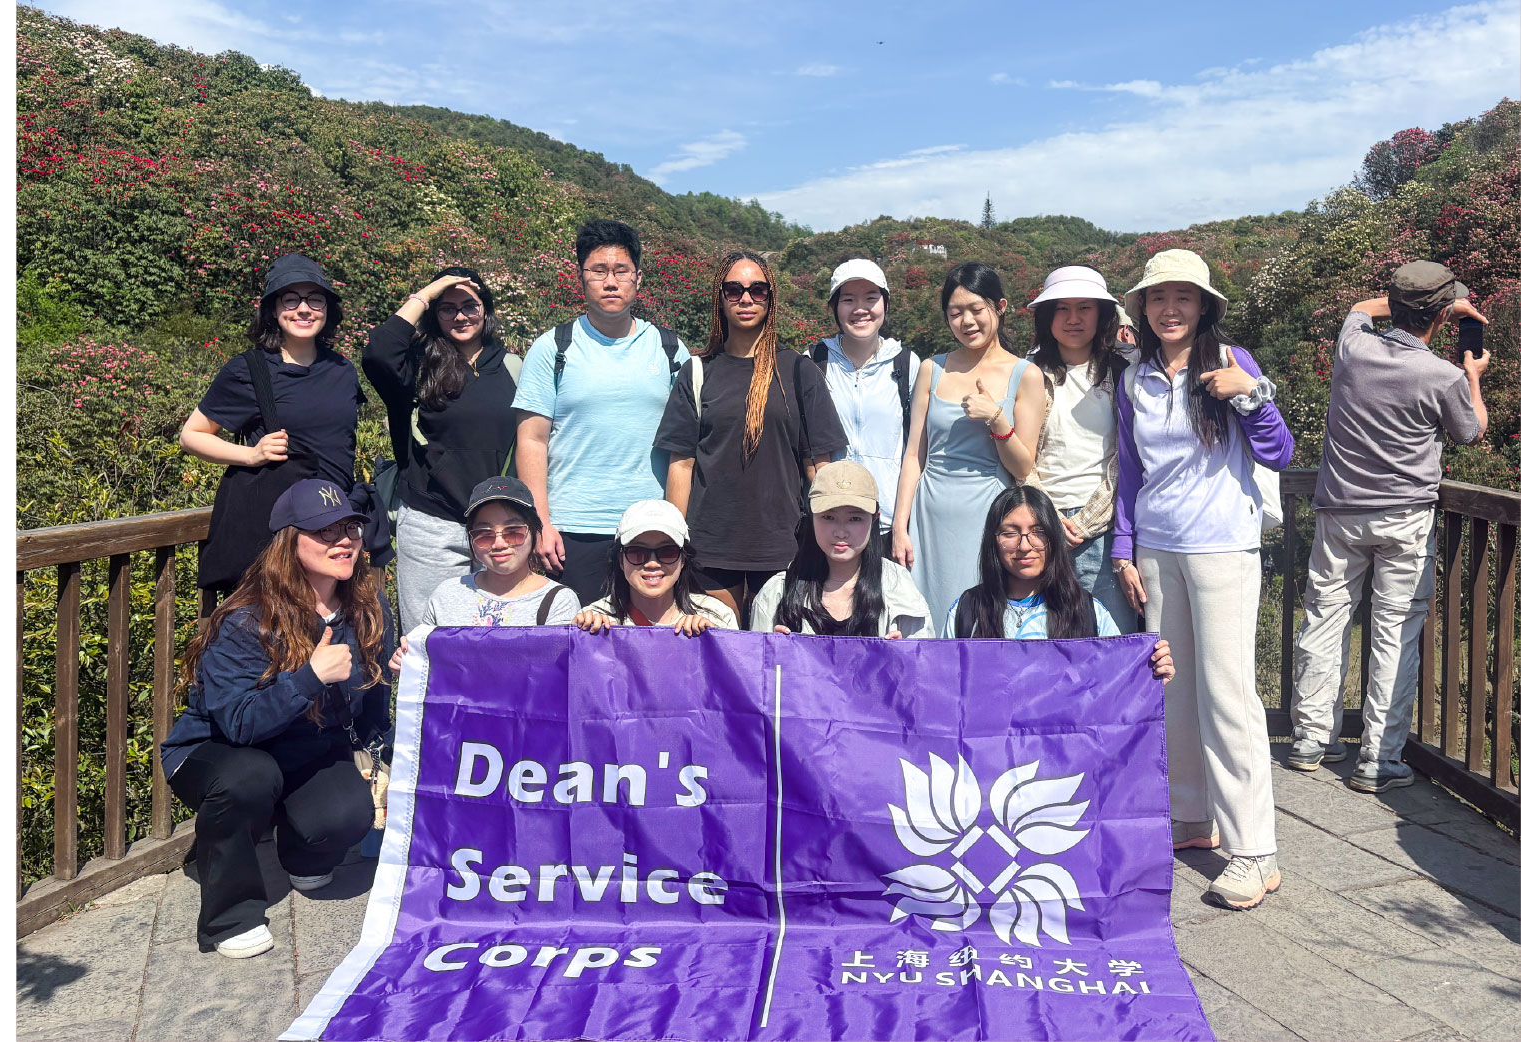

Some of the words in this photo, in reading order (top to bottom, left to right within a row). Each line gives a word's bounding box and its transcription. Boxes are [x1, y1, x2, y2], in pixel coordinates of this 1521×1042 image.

[454, 741, 708, 807] Dean's
[446, 848, 729, 905] Service
[423, 942, 662, 978] Corps
[841, 945, 1145, 977] 上海纽约大学
[841, 971, 922, 985] NYU
[935, 964, 1152, 995] SHANGHAI
